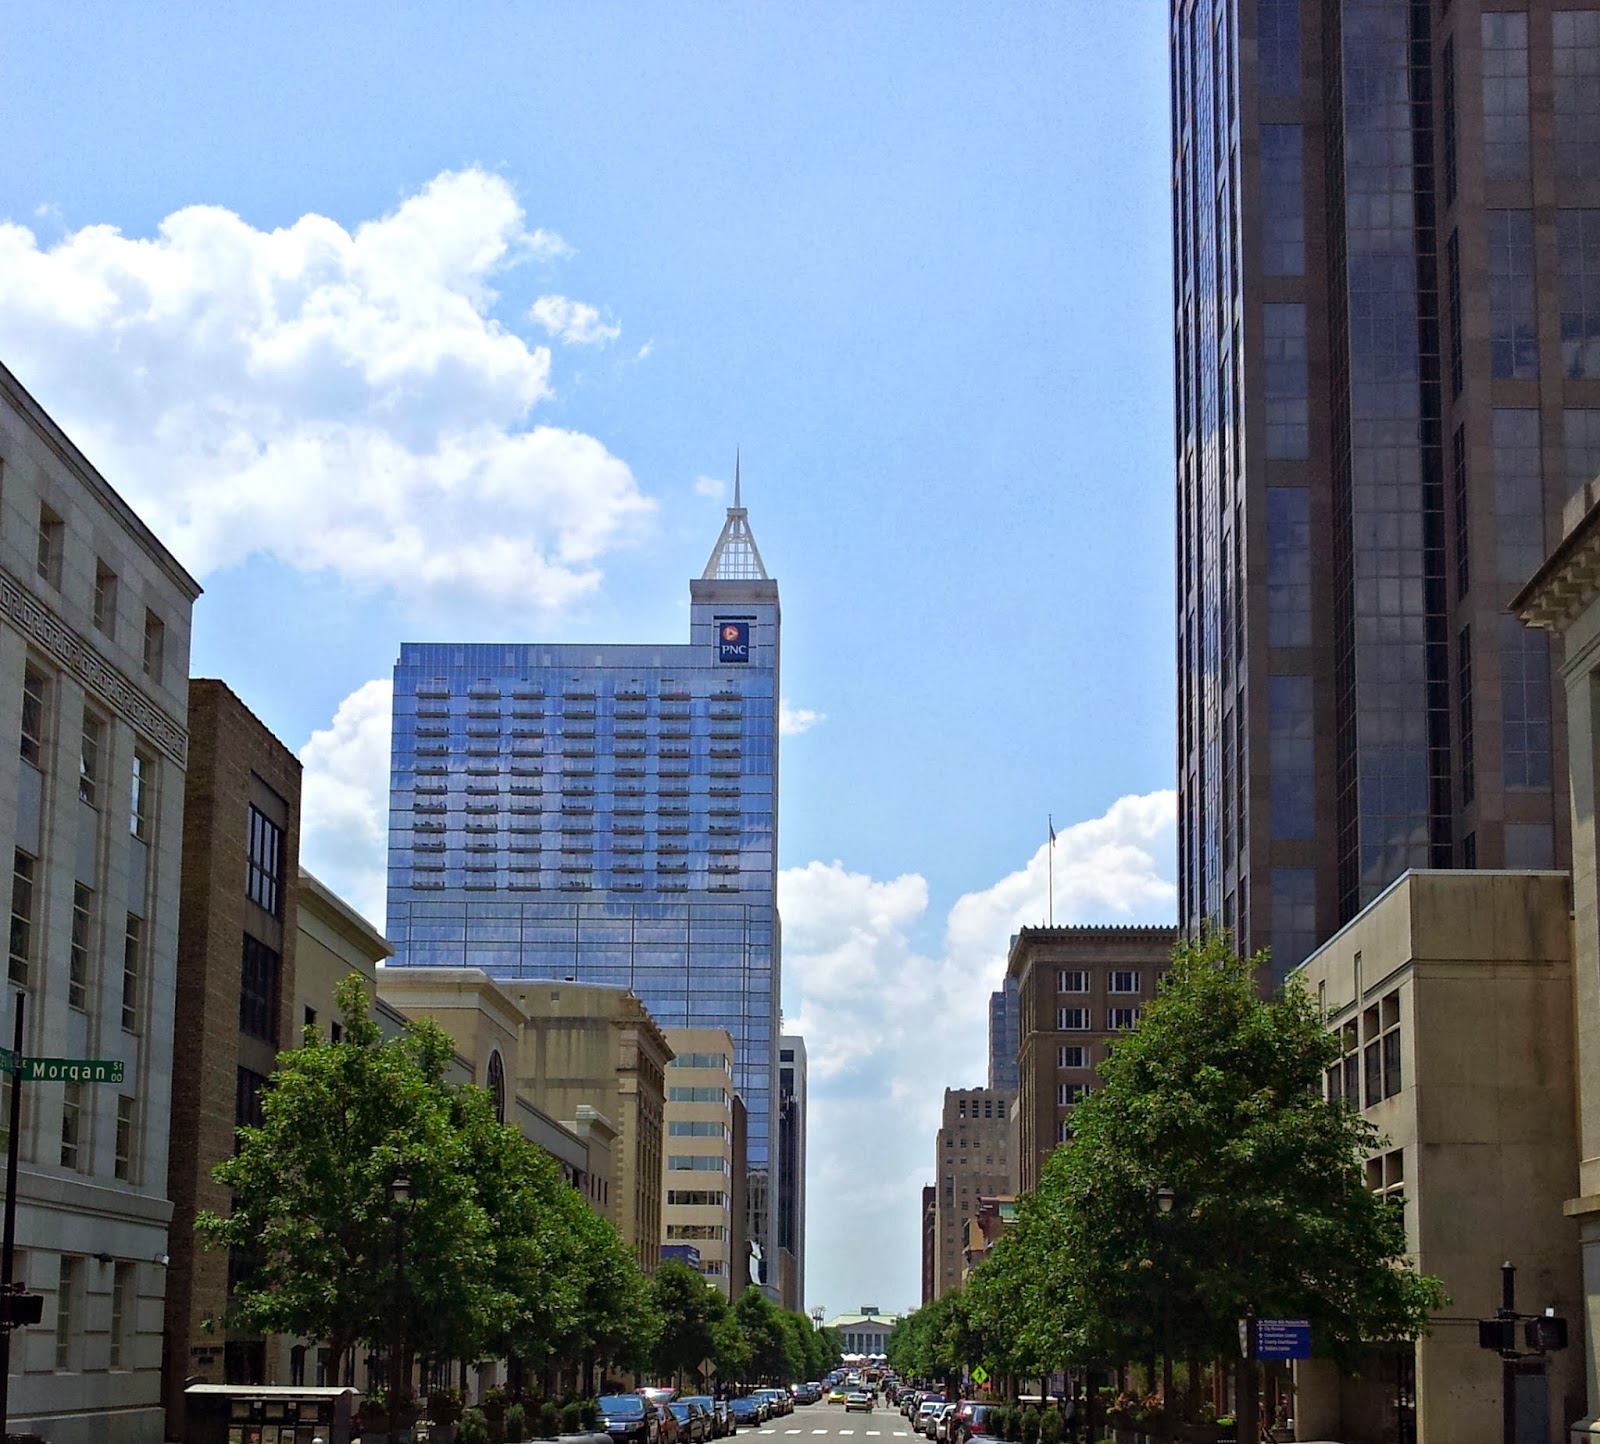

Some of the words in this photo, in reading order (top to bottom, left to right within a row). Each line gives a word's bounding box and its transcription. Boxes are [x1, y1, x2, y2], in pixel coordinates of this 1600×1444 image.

[721, 645, 747, 655] PNC
[22, 1060, 28, 1068] E
[32, 1061, 105, 1081] Morgan
[112, 1062, 123, 1071] St
